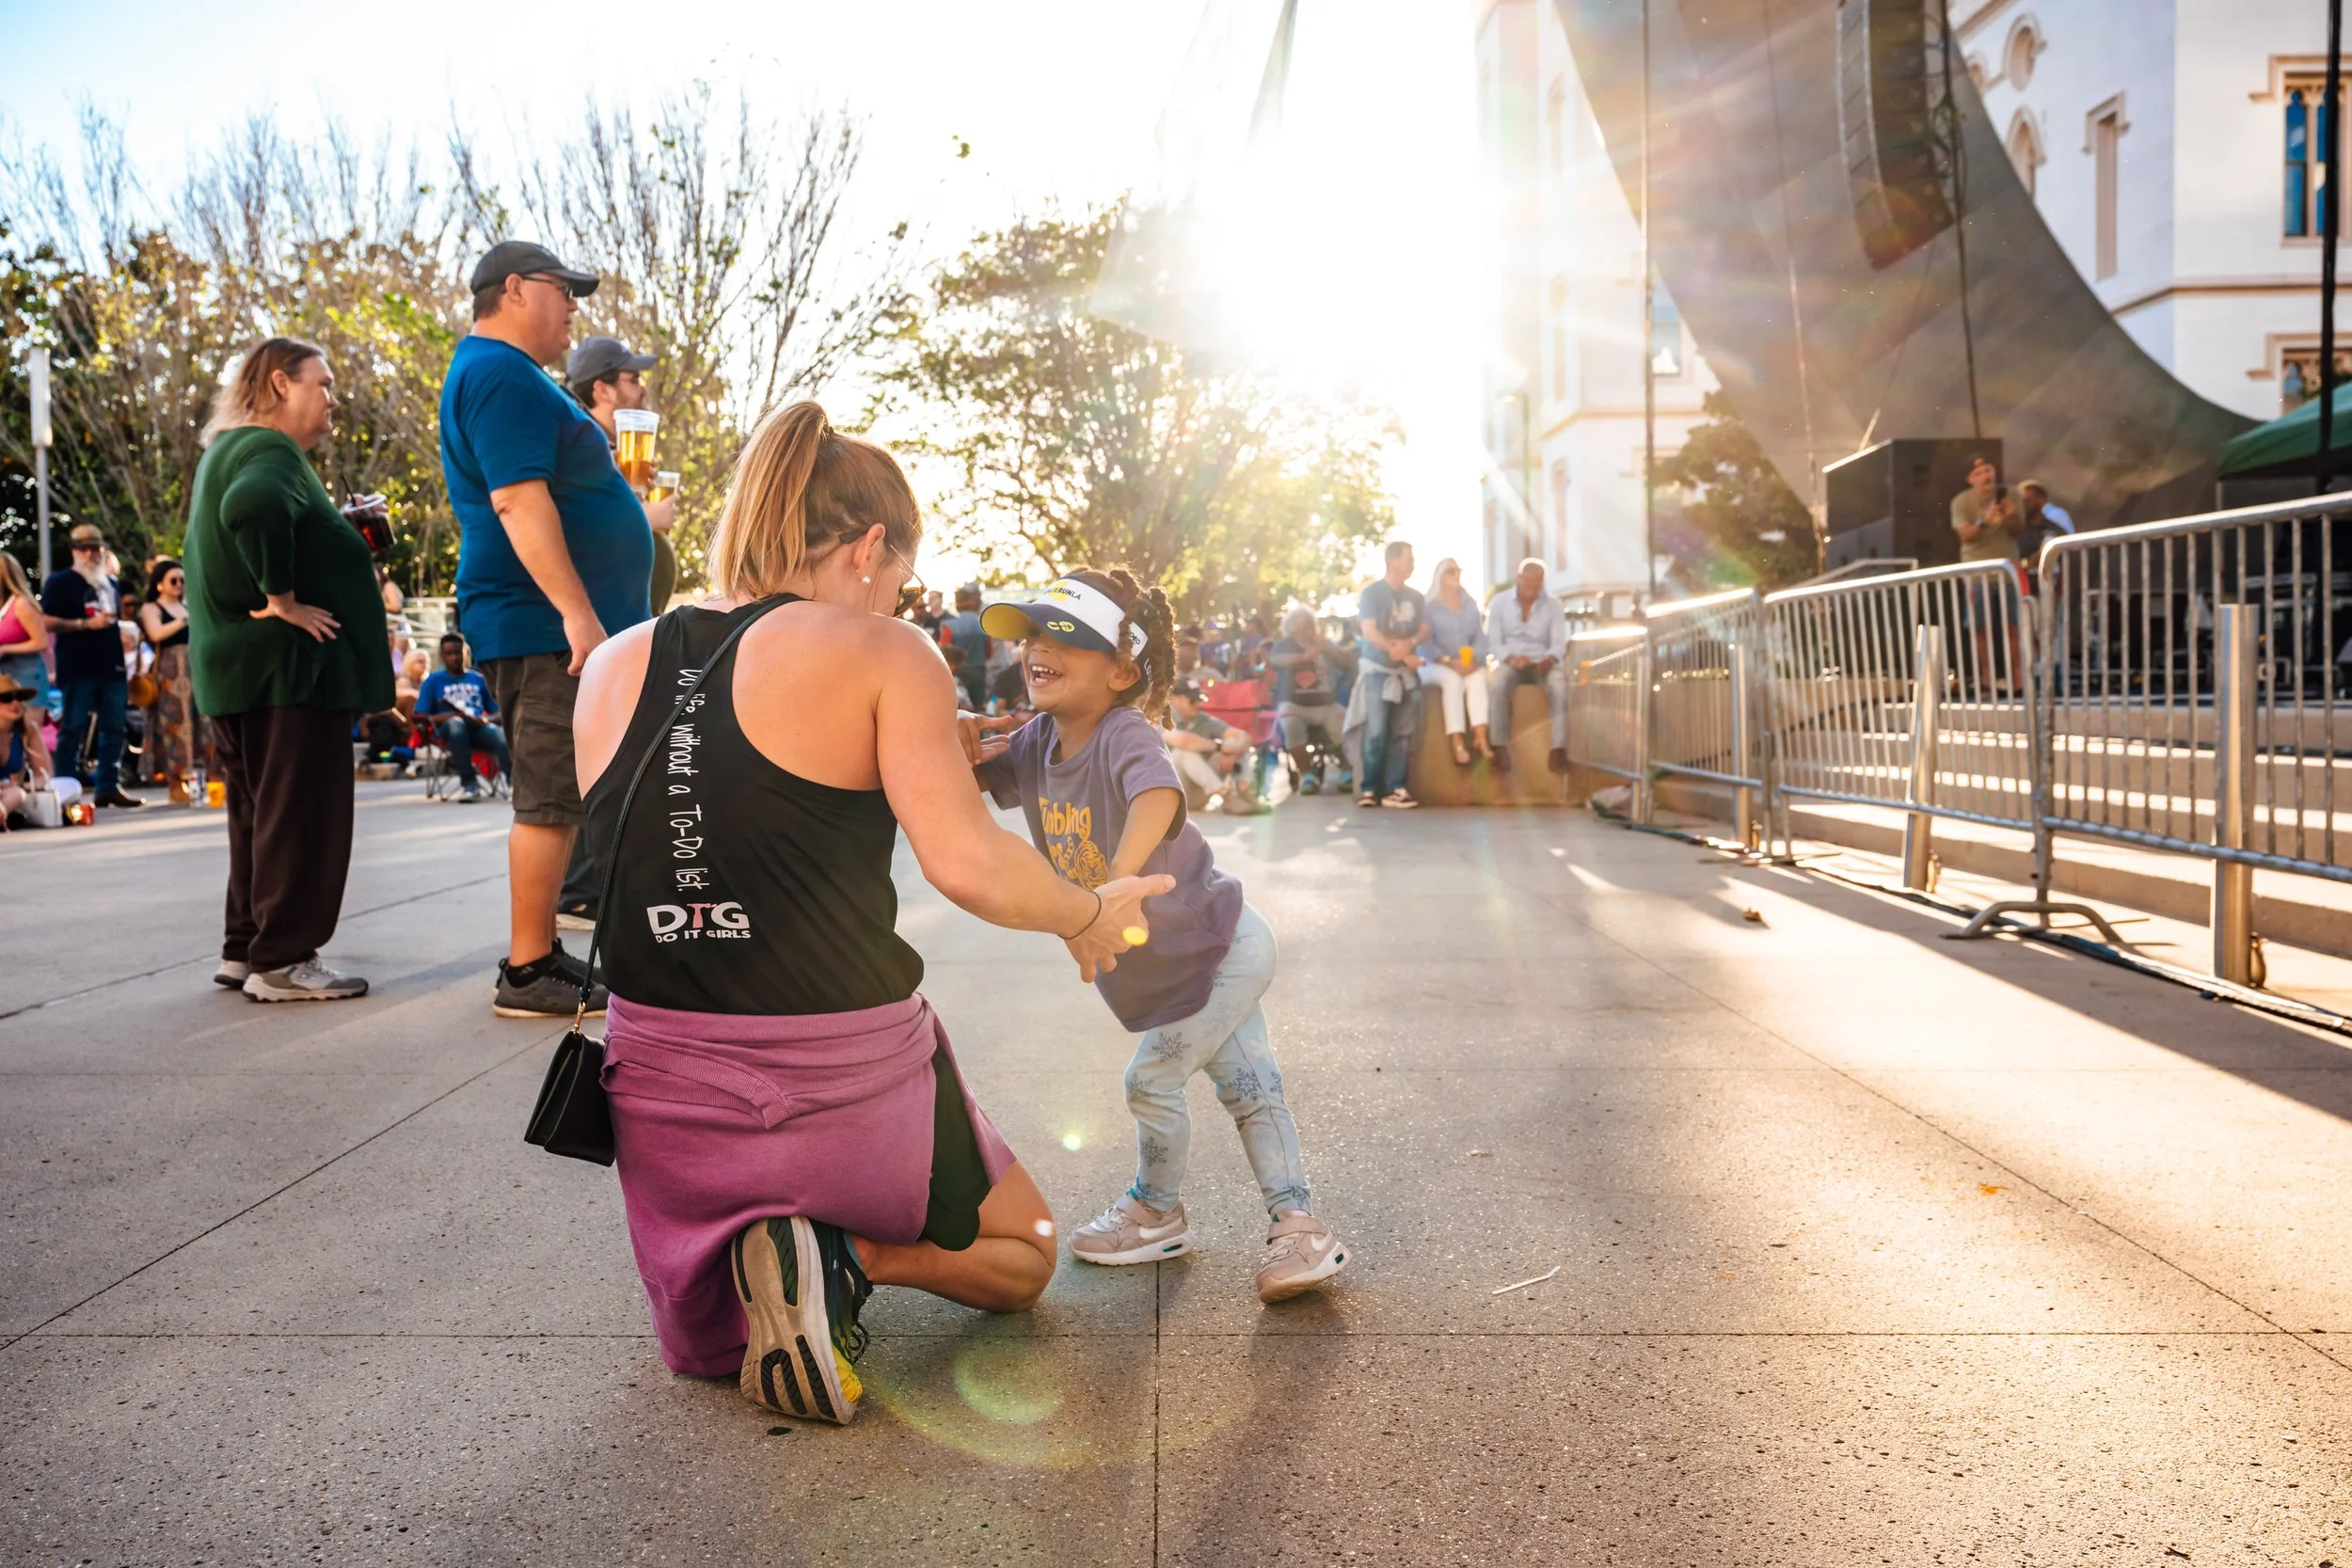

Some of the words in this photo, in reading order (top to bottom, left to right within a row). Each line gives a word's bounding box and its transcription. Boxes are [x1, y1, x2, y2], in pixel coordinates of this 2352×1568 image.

[667, 723, 701, 776] without
[668, 784, 691, 796] a
[669, 803, 704, 859] To-Do
[655, 932, 678, 943] DO
[684, 929, 701, 940] IT
[706, 929, 752, 939] GIRLS
